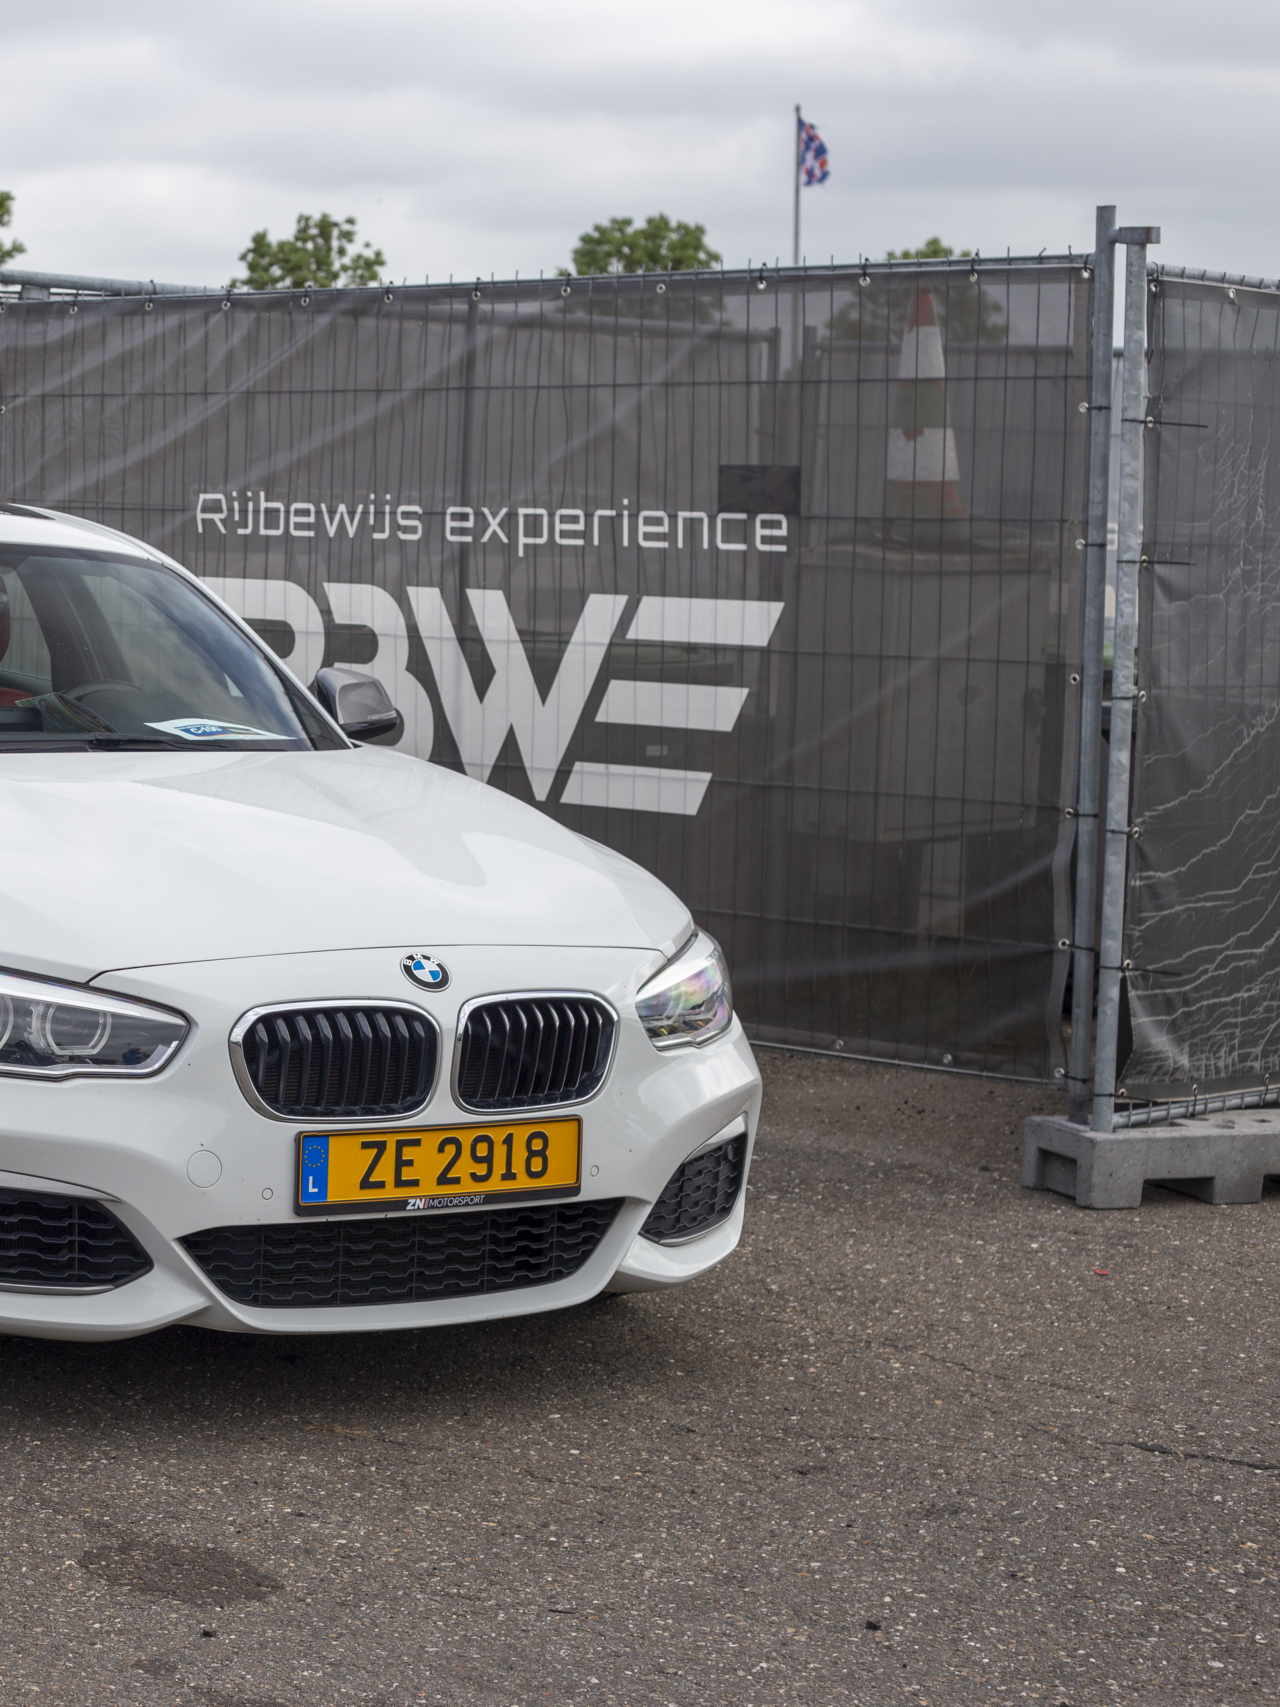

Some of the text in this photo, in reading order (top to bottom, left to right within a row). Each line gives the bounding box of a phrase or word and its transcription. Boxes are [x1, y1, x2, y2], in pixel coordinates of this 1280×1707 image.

[196, 492, 788, 557] Rijbewijs experience
[403, 953, 439, 966] BMW
[359, 1130, 549, 1190] ZE 2918
[308, 1175, 318, 1193] L
[428, 1194, 486, 1208] MOTORSPORT
